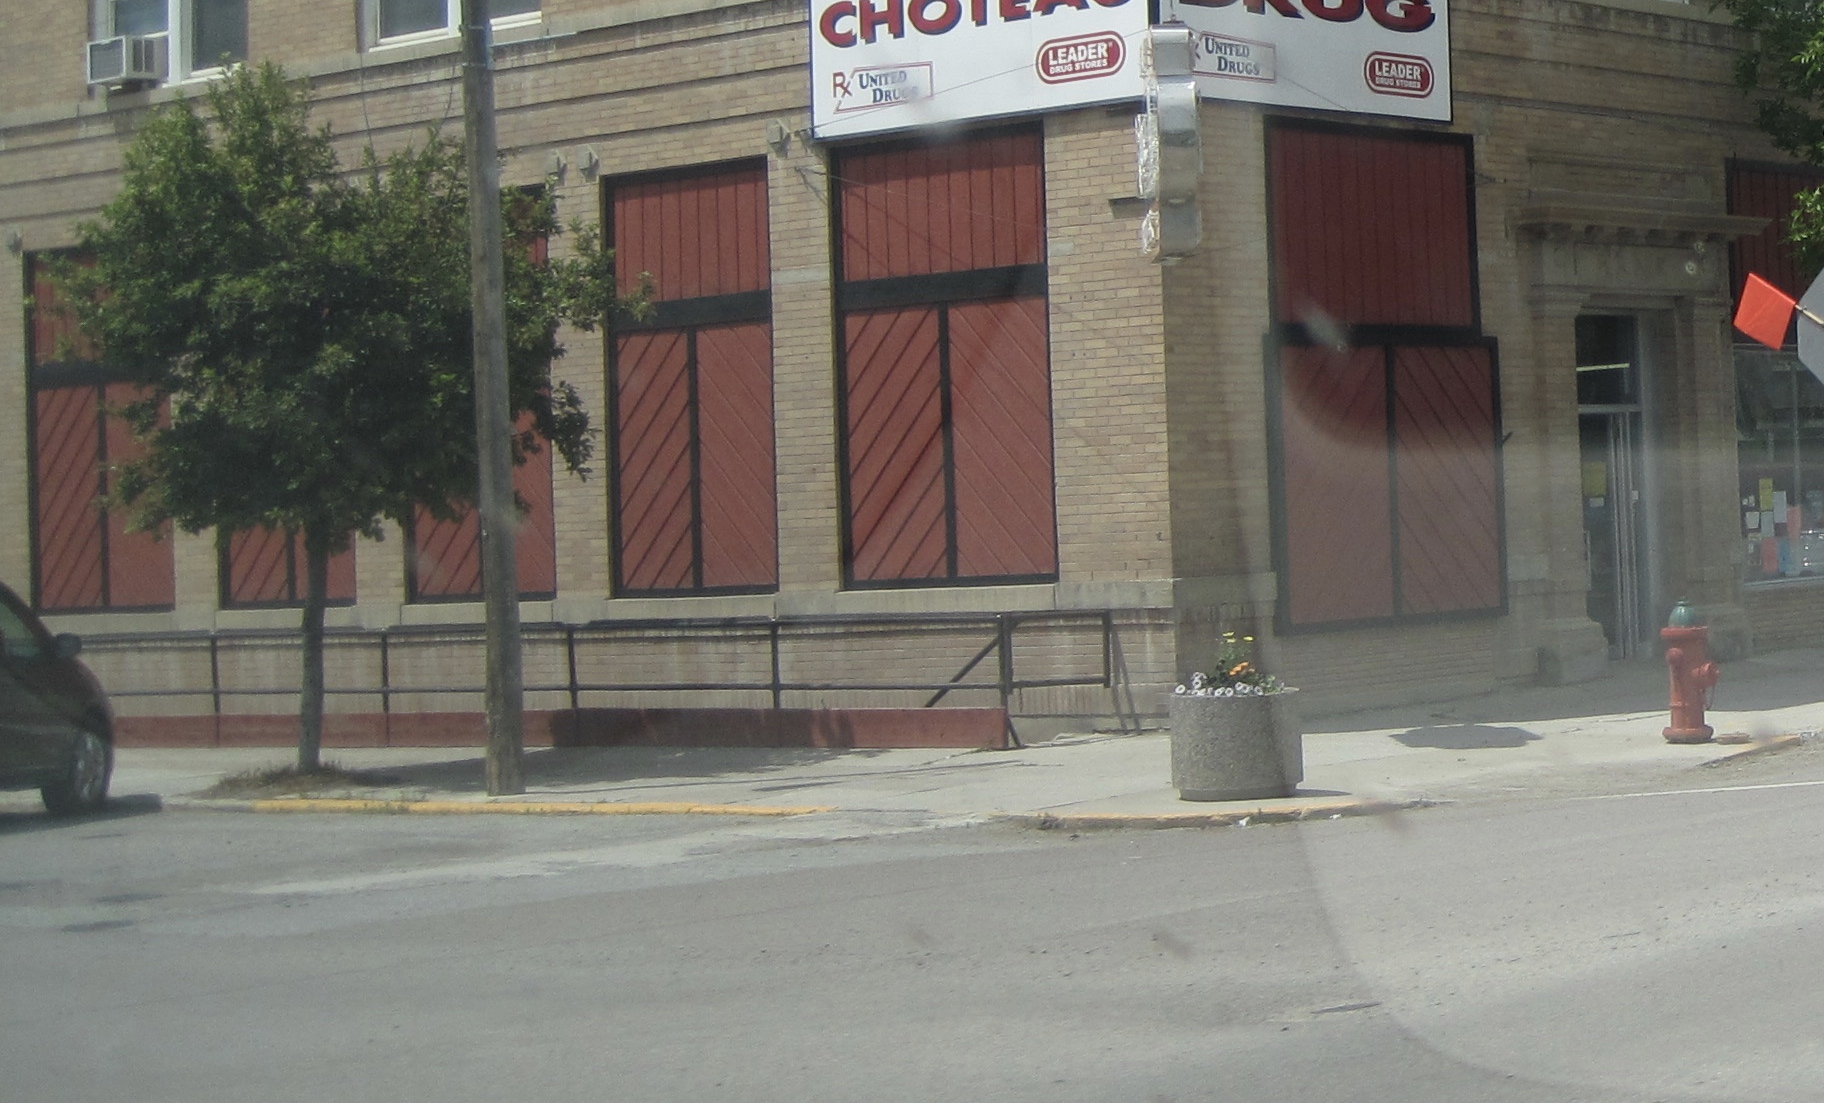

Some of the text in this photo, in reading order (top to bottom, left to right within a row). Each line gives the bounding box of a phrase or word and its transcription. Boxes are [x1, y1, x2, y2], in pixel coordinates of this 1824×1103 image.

[1048, 41, 1109, 66] LEADER
[1204, 36, 1250, 58] UNITED
[1049, 58, 1108, 75] DRUG STORES
[1216, 56, 1260, 76] DRUGS
[1374, 60, 1421, 81] LEADER
